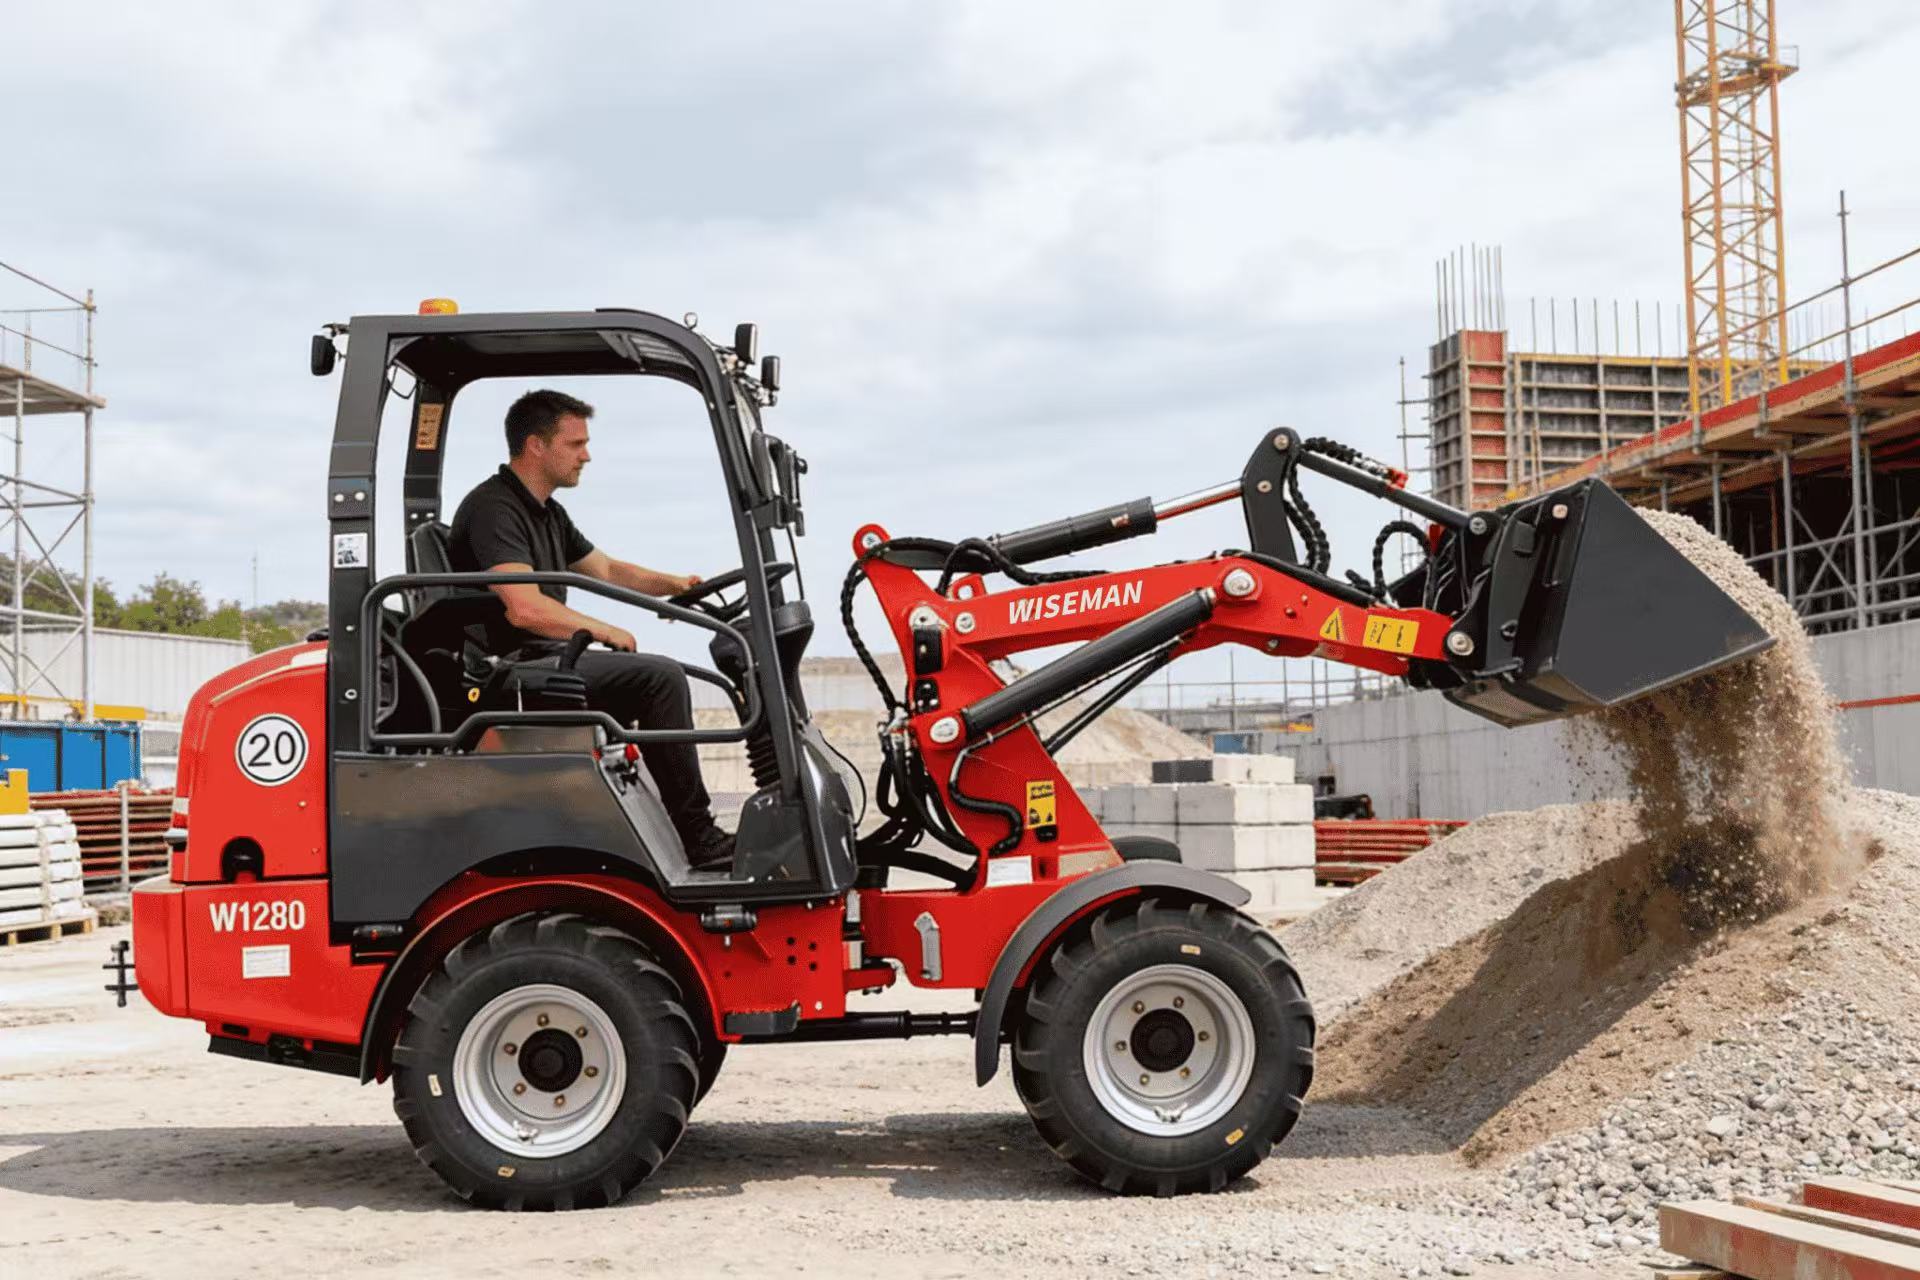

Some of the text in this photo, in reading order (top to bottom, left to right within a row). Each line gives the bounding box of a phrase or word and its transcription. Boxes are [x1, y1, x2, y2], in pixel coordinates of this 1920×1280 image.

[1009, 580, 1143, 625] WISEMAN
[248, 730, 296, 767] 20
[209, 900, 306, 933] W1280
